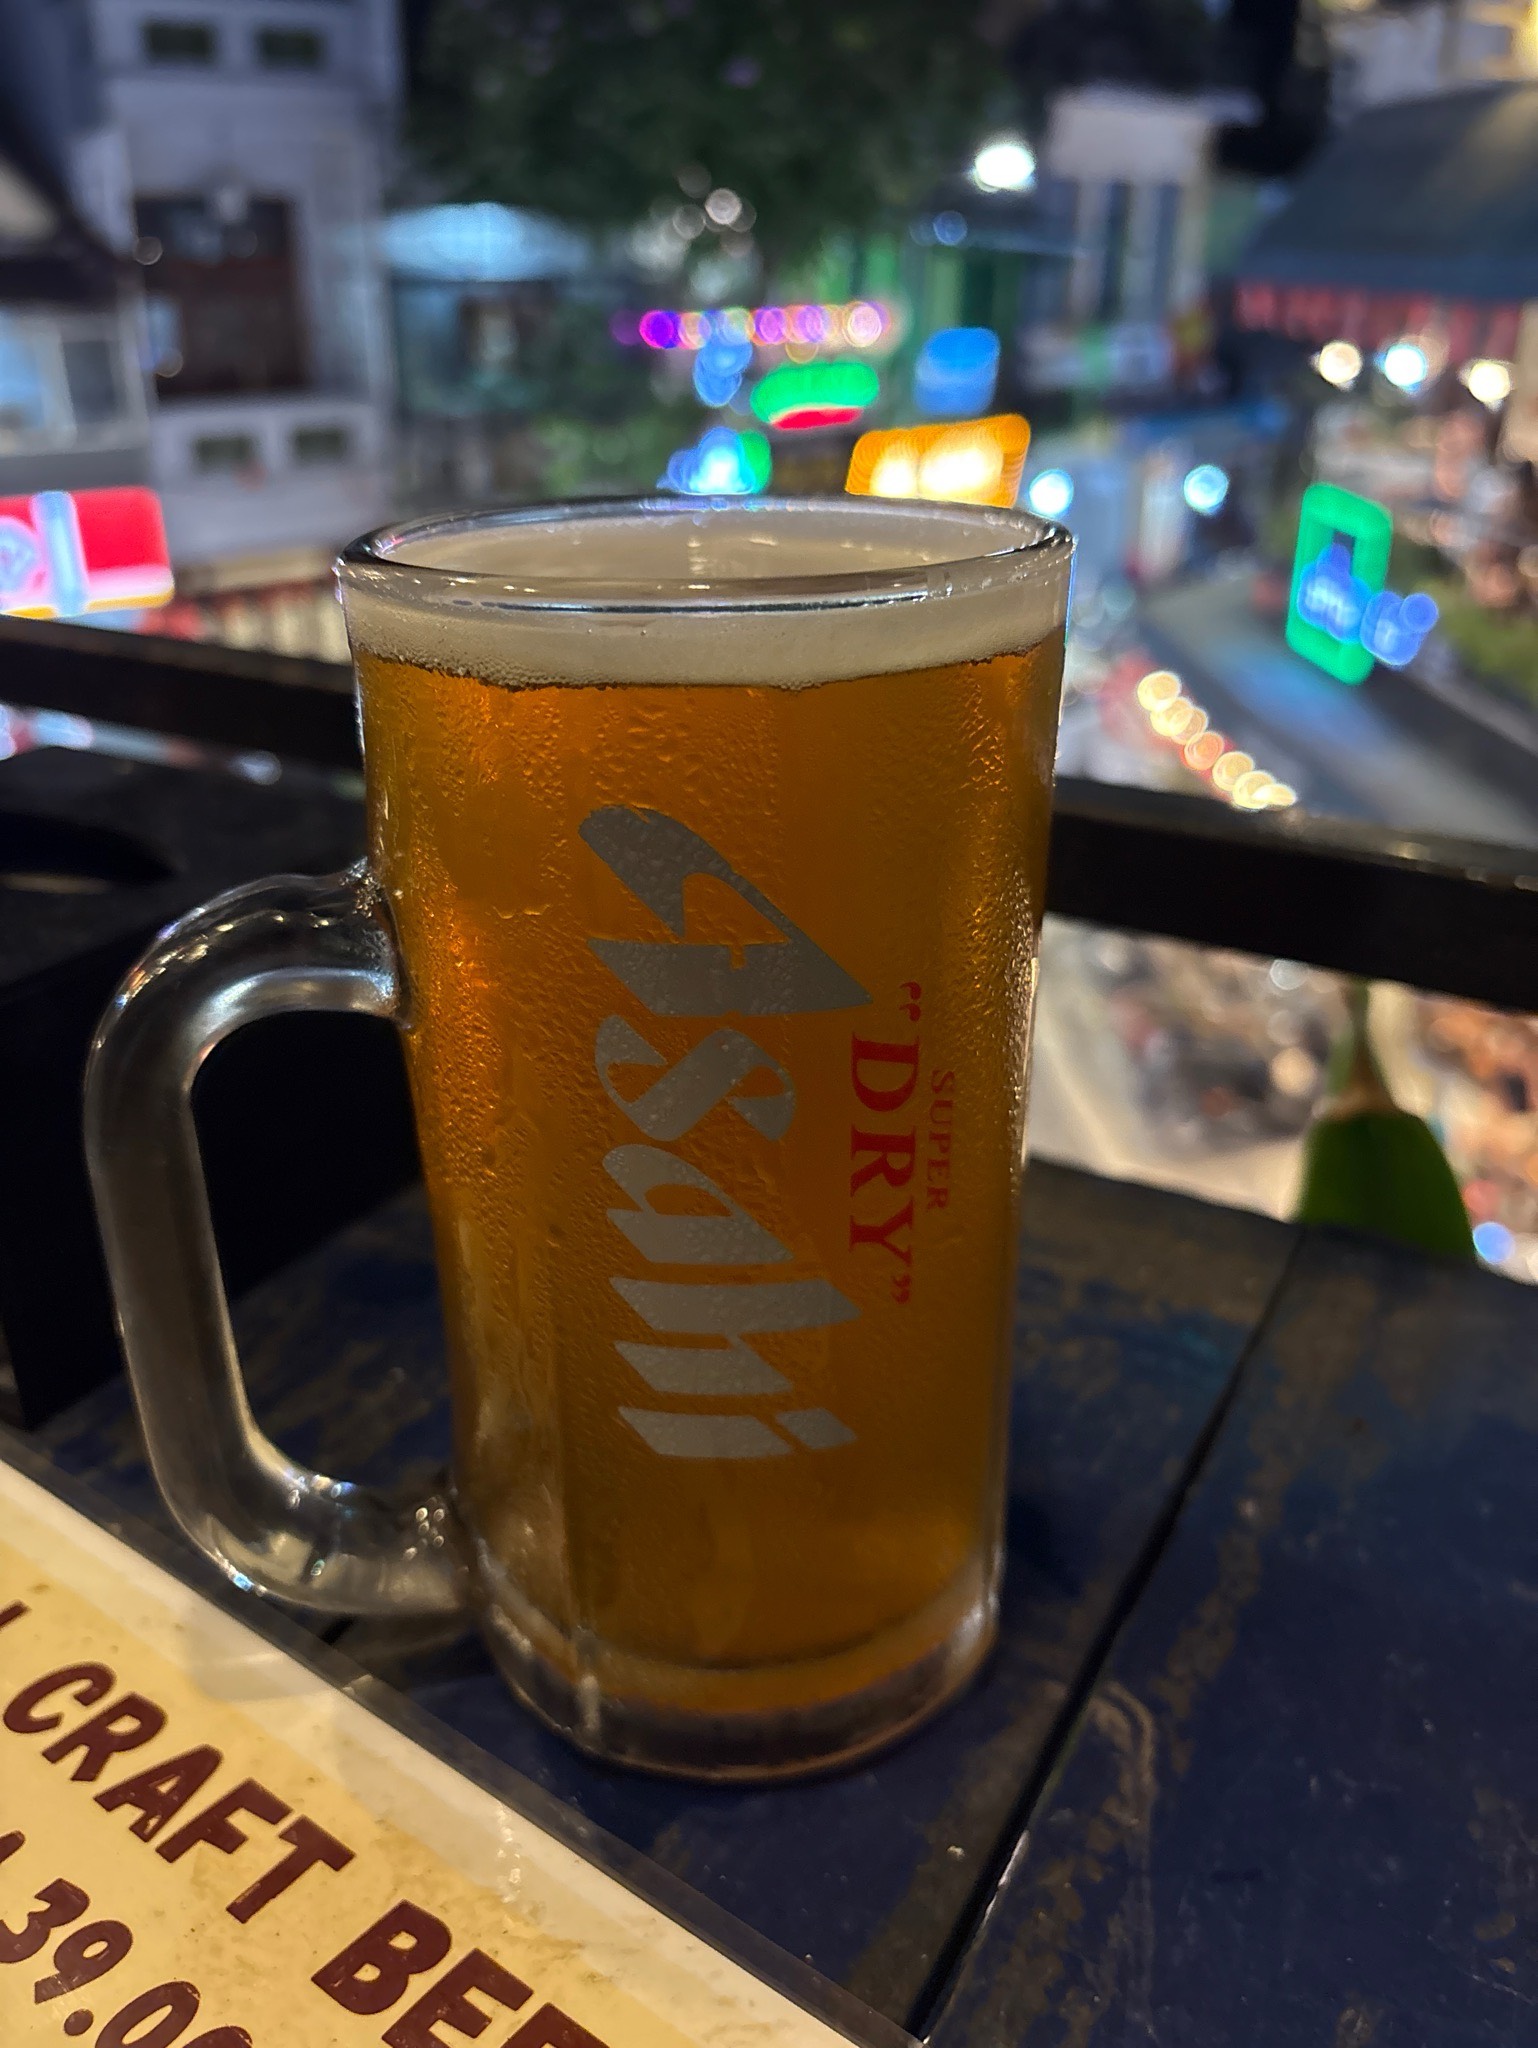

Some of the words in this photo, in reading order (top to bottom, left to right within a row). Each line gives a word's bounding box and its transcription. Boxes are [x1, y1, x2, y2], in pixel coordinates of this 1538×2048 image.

[579, 804, 873, 1459] Asahi
[926, 1068, 956, 1211] SUPER
[3, 1661, 356, 1924] CRAFT
[0, 1878, 253, 2048] 39.0
